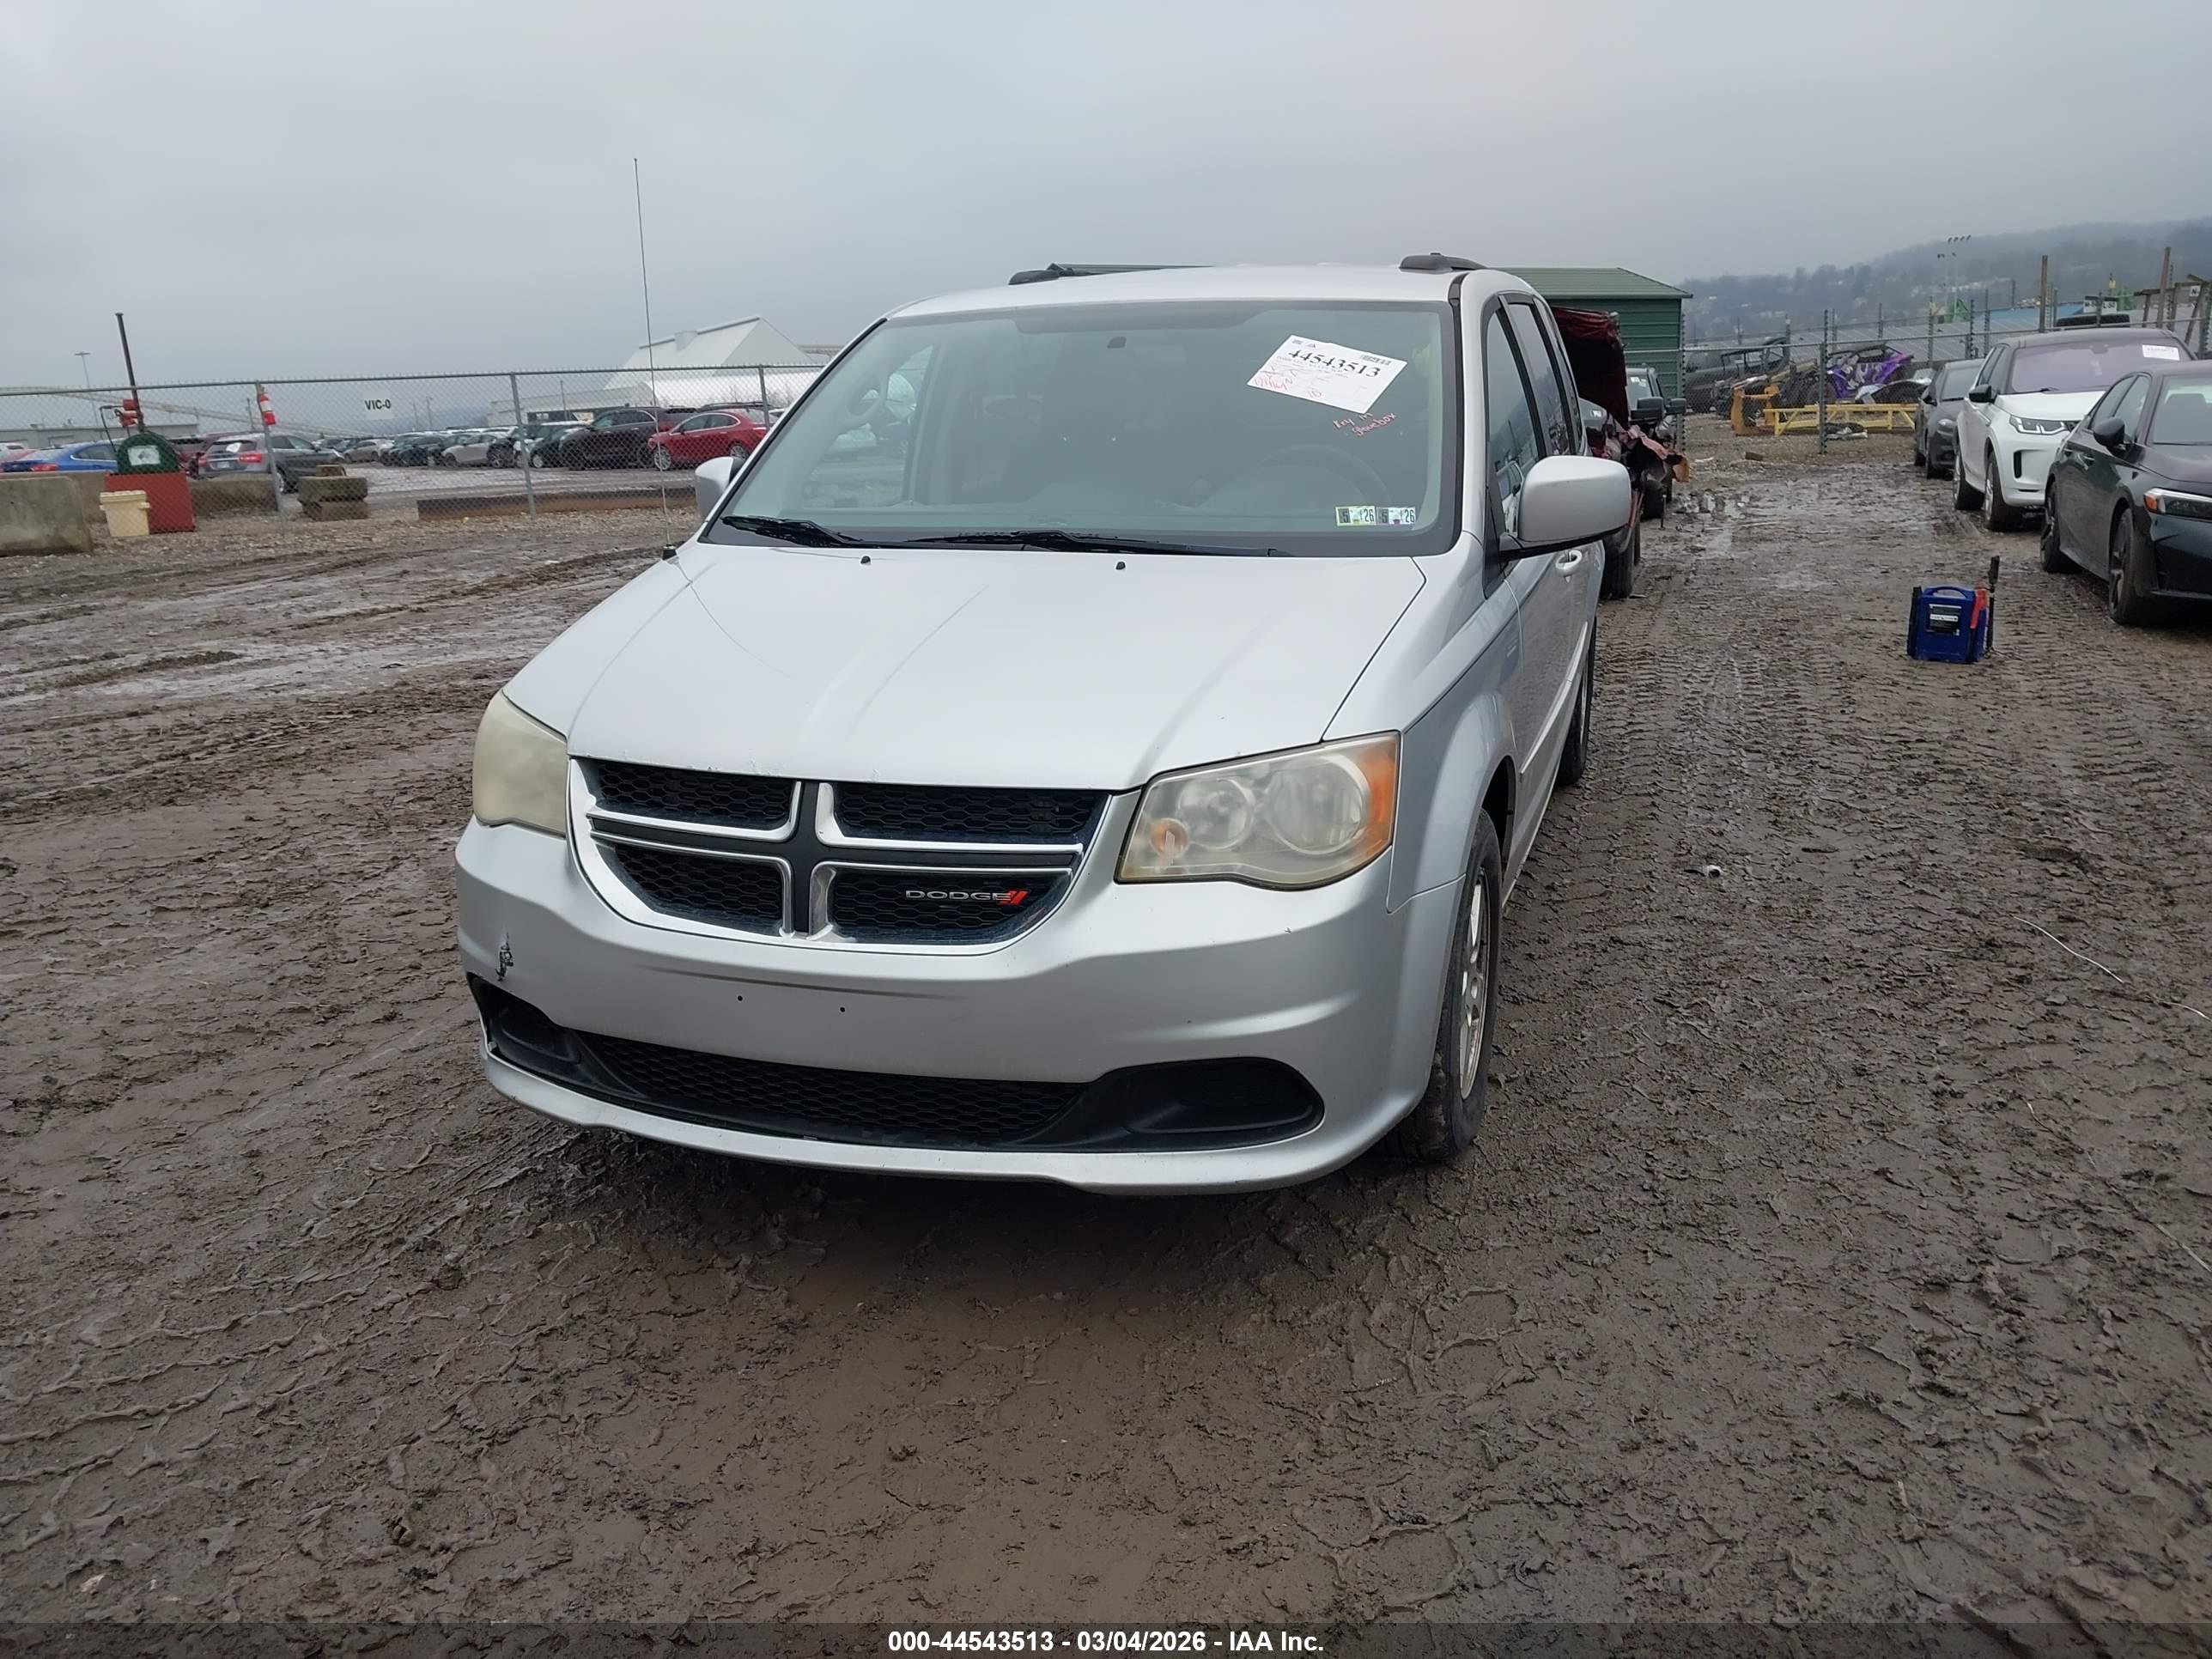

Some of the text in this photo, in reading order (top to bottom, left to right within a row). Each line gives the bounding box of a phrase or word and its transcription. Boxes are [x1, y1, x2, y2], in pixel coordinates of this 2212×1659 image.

[1288, 349, 1381, 377] 44543513
[1364, 508, 1374, 522] 26
[1405, 508, 1415, 523] 26
[905, 890, 1012, 901] DODGE
